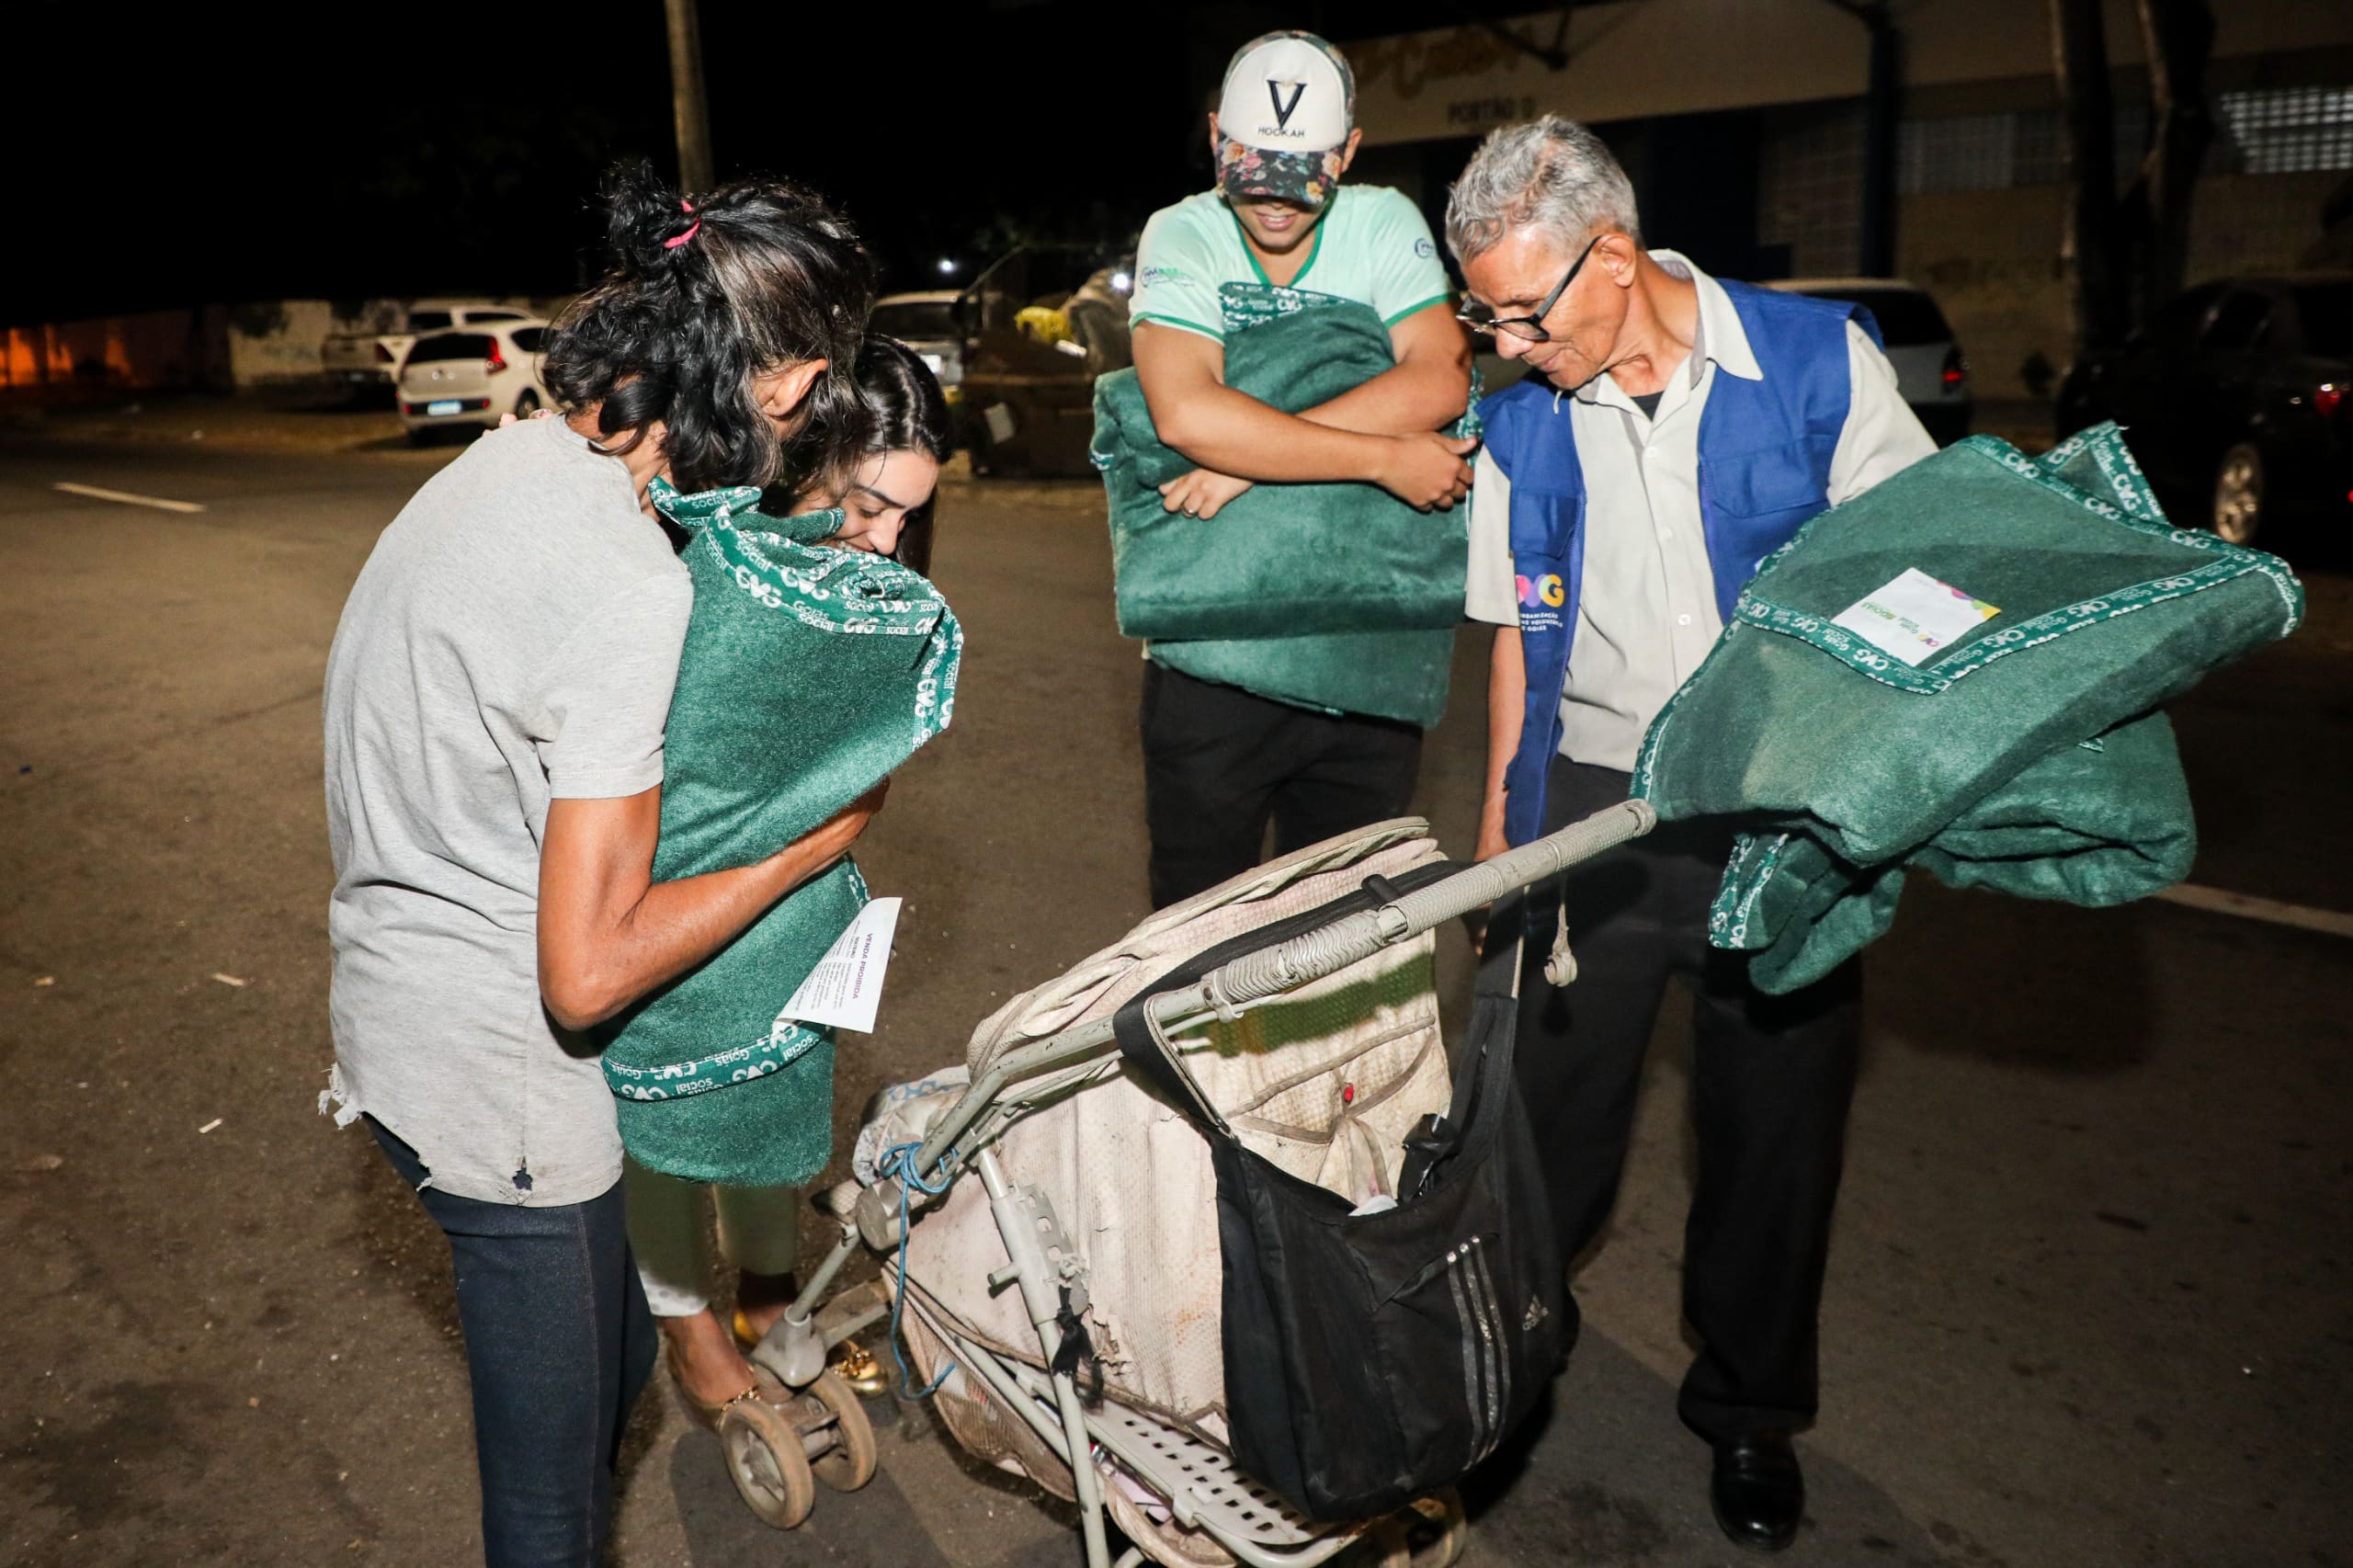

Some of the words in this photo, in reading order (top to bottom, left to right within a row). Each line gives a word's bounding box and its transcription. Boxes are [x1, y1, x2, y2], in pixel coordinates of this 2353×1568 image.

[1267, 80, 1307, 129] V
[1258, 127, 1305, 137] HOOKAH
[861, 933, 873, 959] VENDA
[853, 960, 867, 999] PROIBIDA
